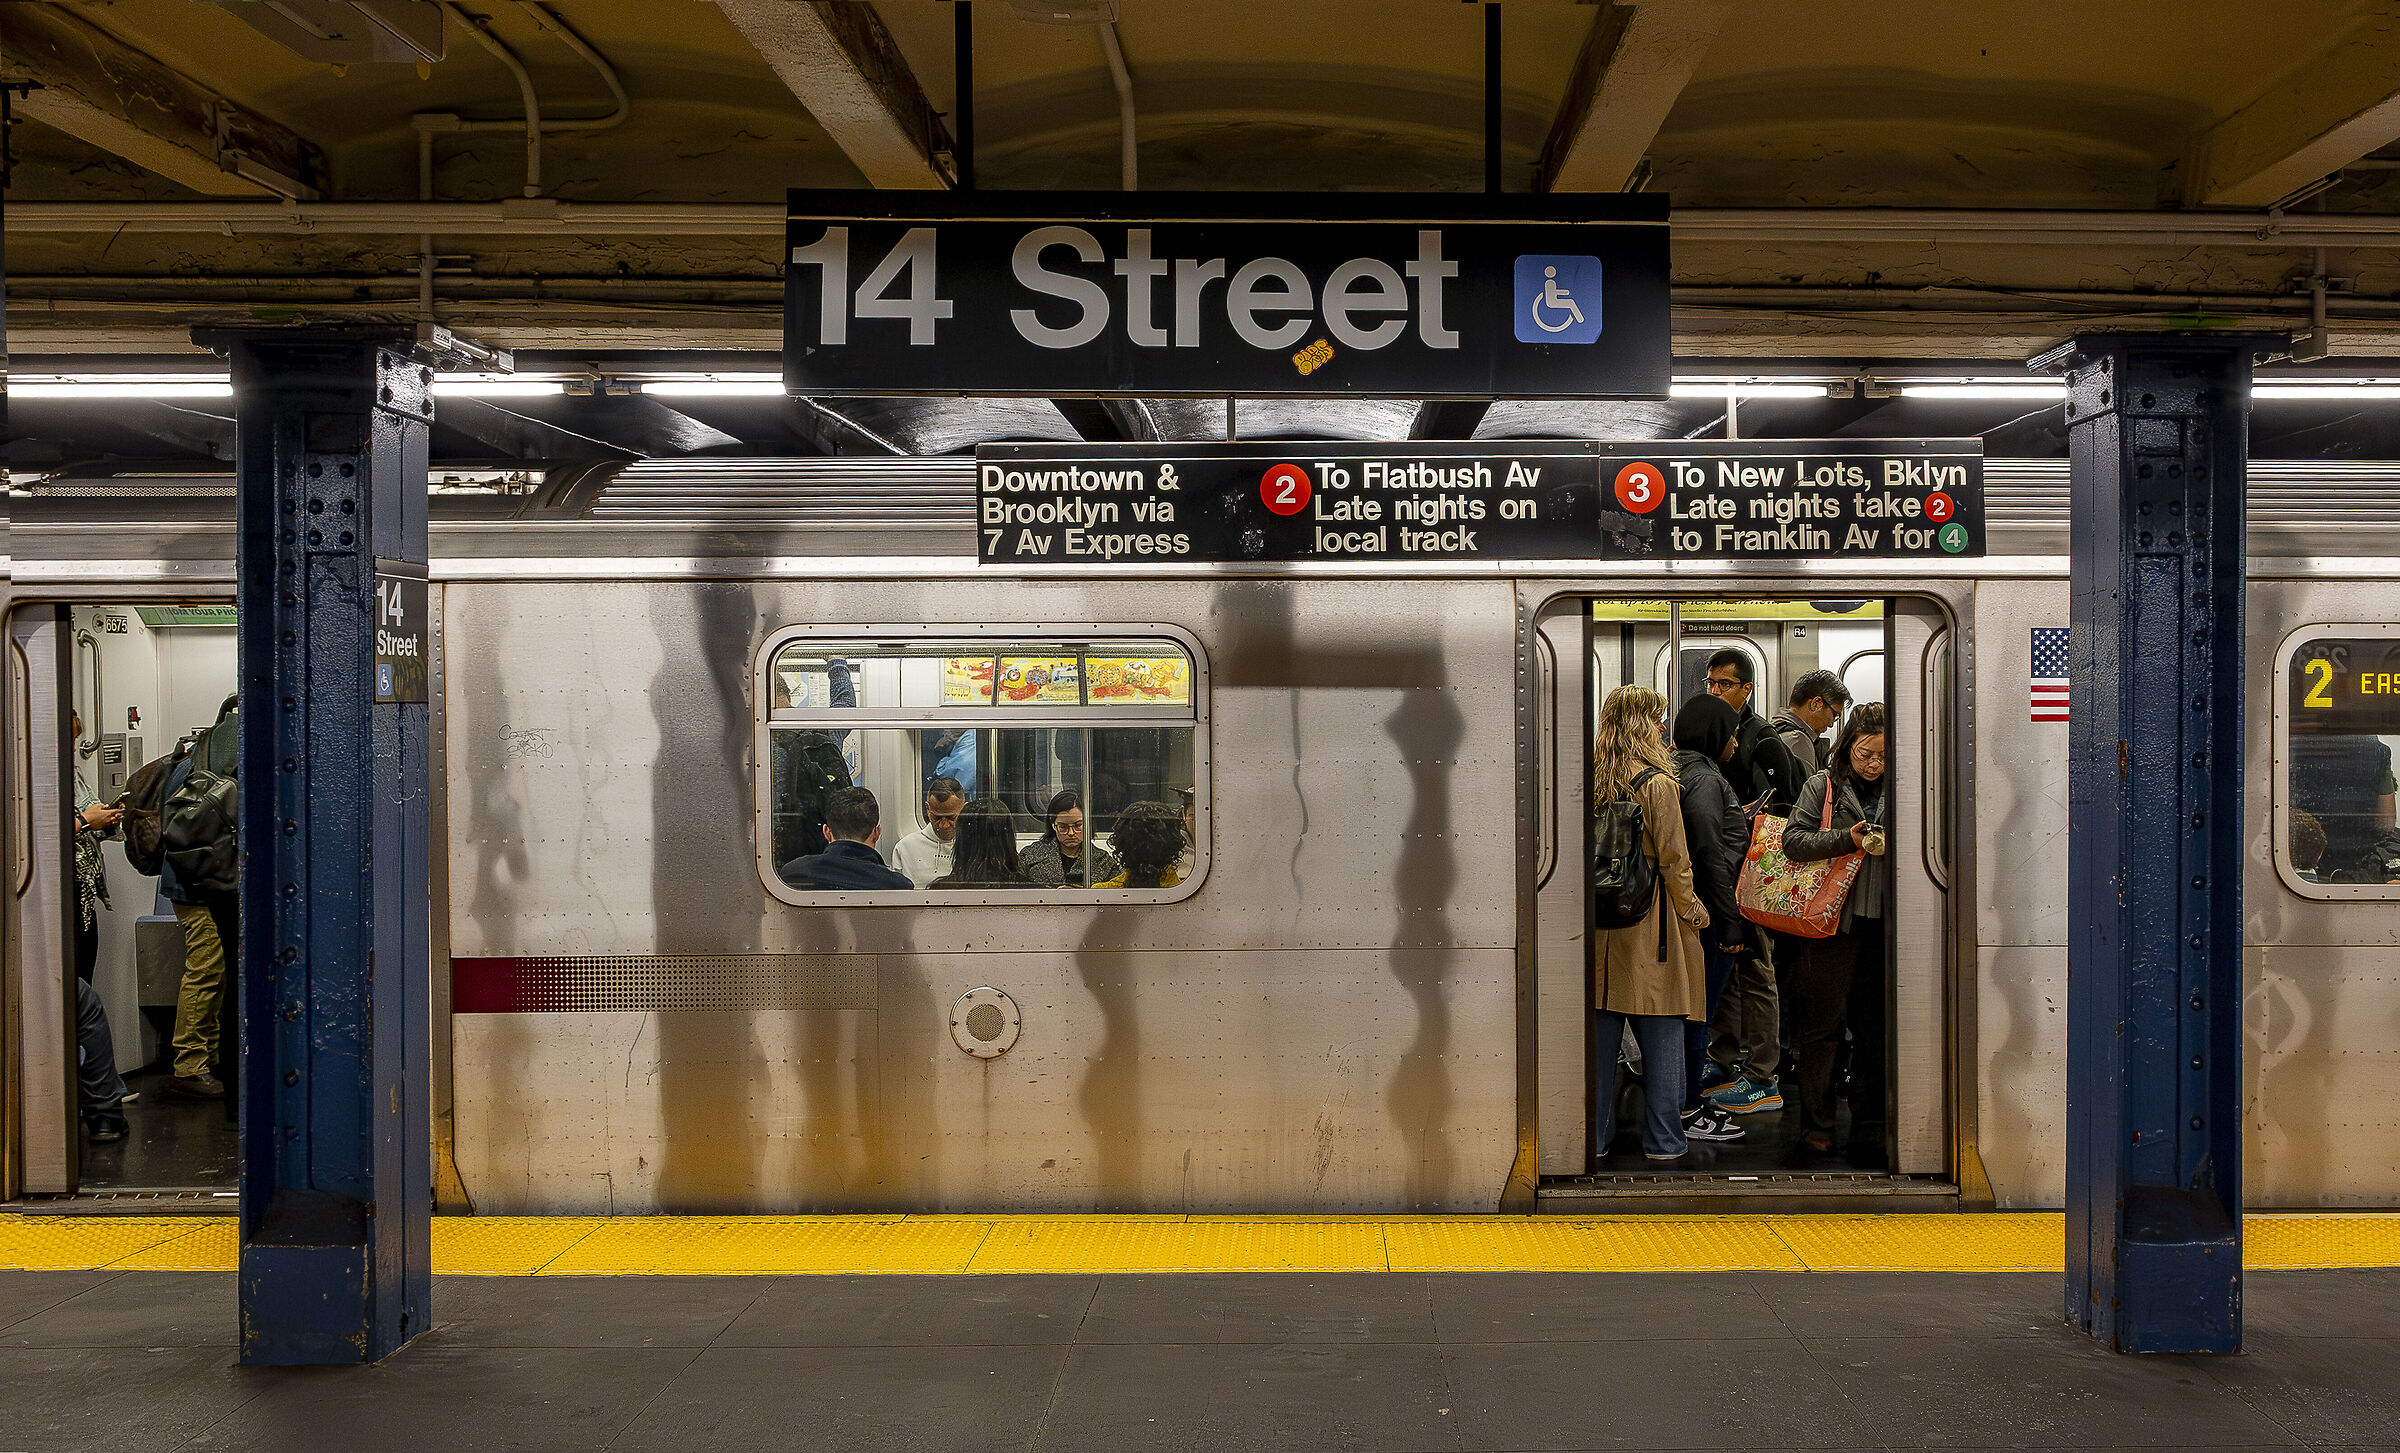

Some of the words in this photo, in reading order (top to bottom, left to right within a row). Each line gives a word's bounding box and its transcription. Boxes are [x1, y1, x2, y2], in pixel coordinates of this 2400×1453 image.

[793, 227, 953, 346] 14
[1010, 226, 1459, 350] Street
[982, 465, 1144, 492] Downtown
[1157, 464, 1180, 491] &
[1276, 476, 1295, 503] 2
[1315, 463, 1350, 489] To
[1364, 462, 1491, 488] Flatbush
[1504, 462, 1541, 487] Av
[1629, 474, 1650, 503] 3
[1670, 462, 1705, 487] To
[1718, 461, 1785, 487] New
[1794, 461, 1871, 491] Lots,
[1884, 460, 1967, 491] Bklyn
[983, 496, 1118, 528] Brooklyn
[1132, 496, 1175, 523] via
[1315, 495, 1382, 521] Late
[1395, 494, 1485, 527] nights
[1500, 499, 1537, 520] on
[1670, 494, 1736, 519] Late
[1749, 493, 1841, 525] nights
[1853, 492, 1921, 518] take
[1932, 499, 1946, 516] 2
[983, 529, 999, 556] 7
[1016, 529, 1052, 555] Av
[1066, 528, 1190, 559] Express
[1316, 527, 1386, 553] local
[1400, 527, 1479, 552] track
[1671, 527, 1702, 552] to
[1716, 524, 1830, 552] Franklin
[1844, 524, 1879, 550] Av
[1893, 523, 1935, 549] for
[1946, 528, 1961, 547] 4
[189, 606, 216, 616] YOUR
[377, 580, 404, 627] 14
[106, 618, 128, 632] 6675
[1794, 628, 1806, 636] R4
[376, 629, 418, 657] Street
[2304, 659, 2333, 708] 2
[1822, 857, 1861, 925] Marshalls
[1747, 1090, 1766, 1102] HOKA
